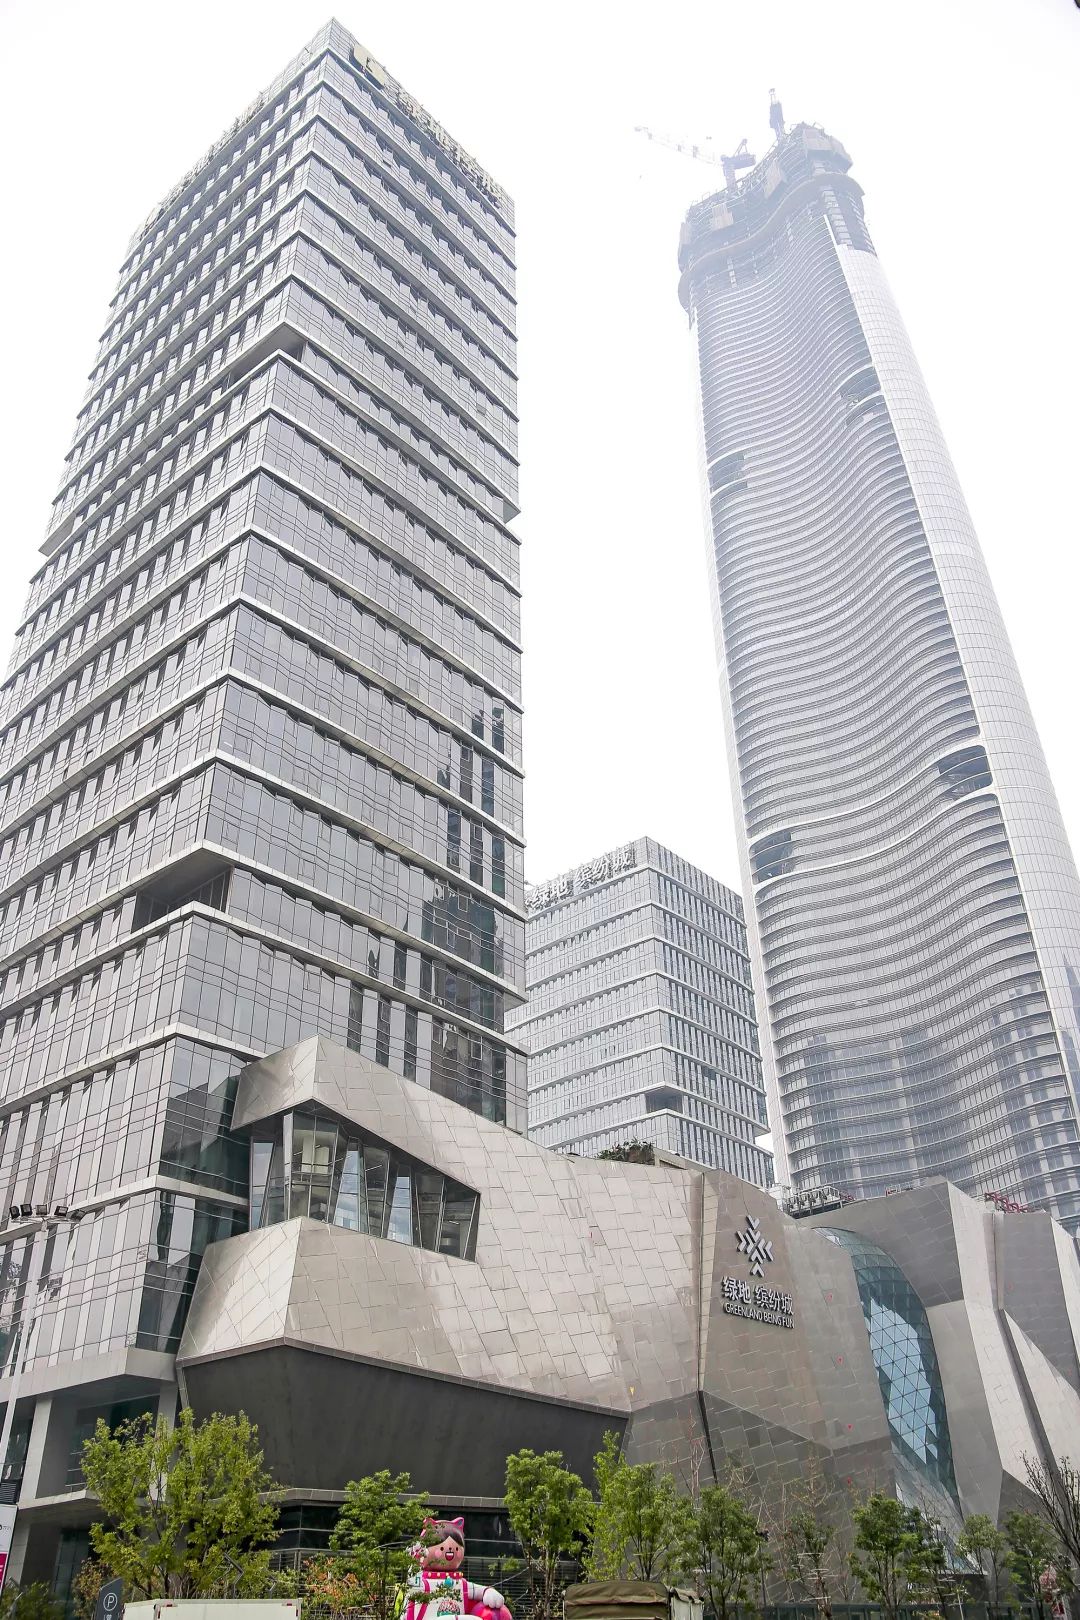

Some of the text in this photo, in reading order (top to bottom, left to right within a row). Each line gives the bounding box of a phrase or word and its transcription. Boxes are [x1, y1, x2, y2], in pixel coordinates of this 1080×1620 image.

[722, 1276, 794, 1316] 绿地 缤纷城
[724, 1302, 795, 1329] GREENLAND BEING FUN
